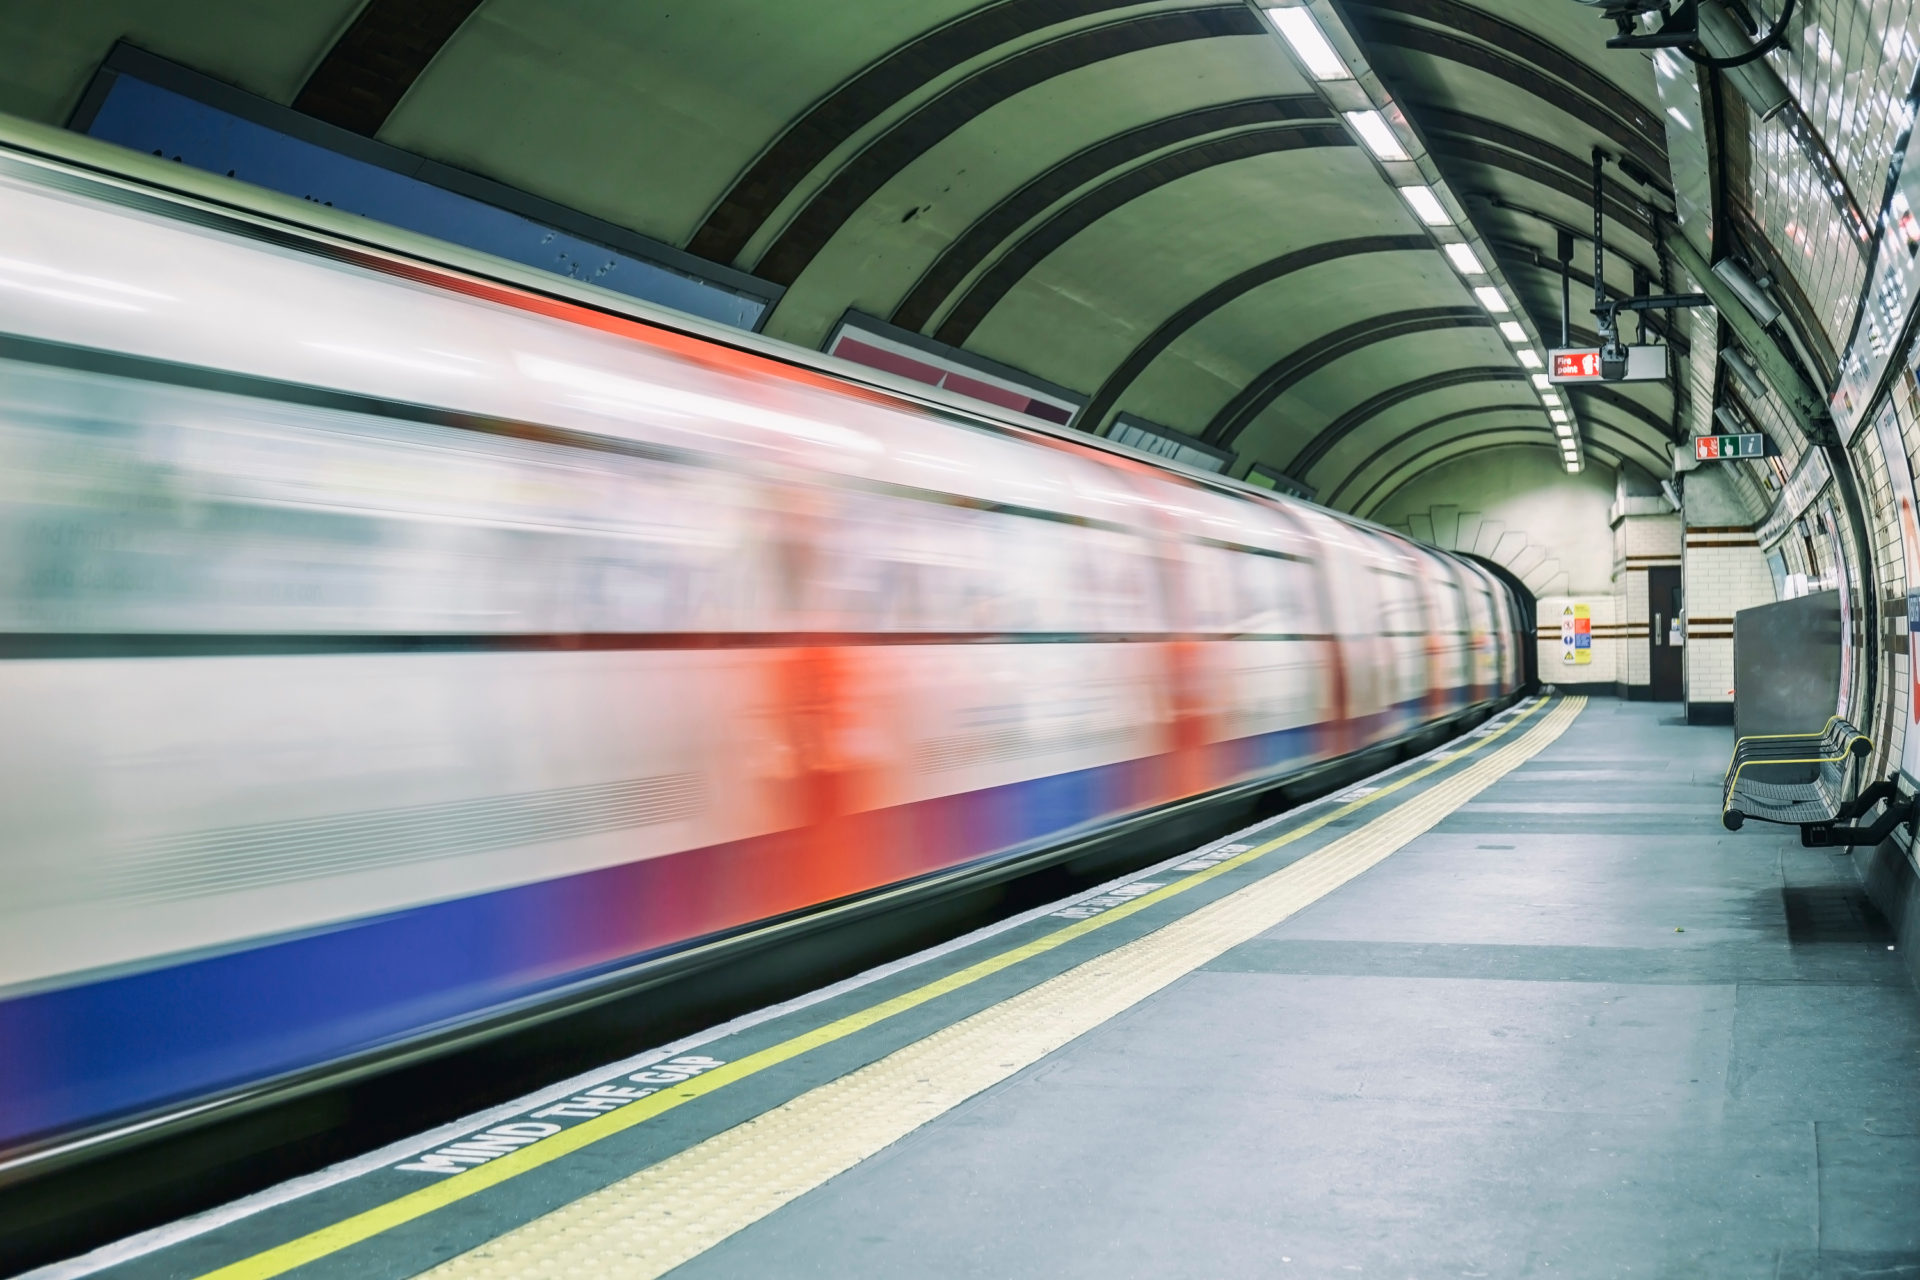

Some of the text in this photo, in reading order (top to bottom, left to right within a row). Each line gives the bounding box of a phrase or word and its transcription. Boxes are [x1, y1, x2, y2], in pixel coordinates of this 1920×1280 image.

[1557, 357, 1572, 365] Fire
[1557, 365, 1578, 374] point
[394, 1055, 727, 1174] MIND THE GAP
